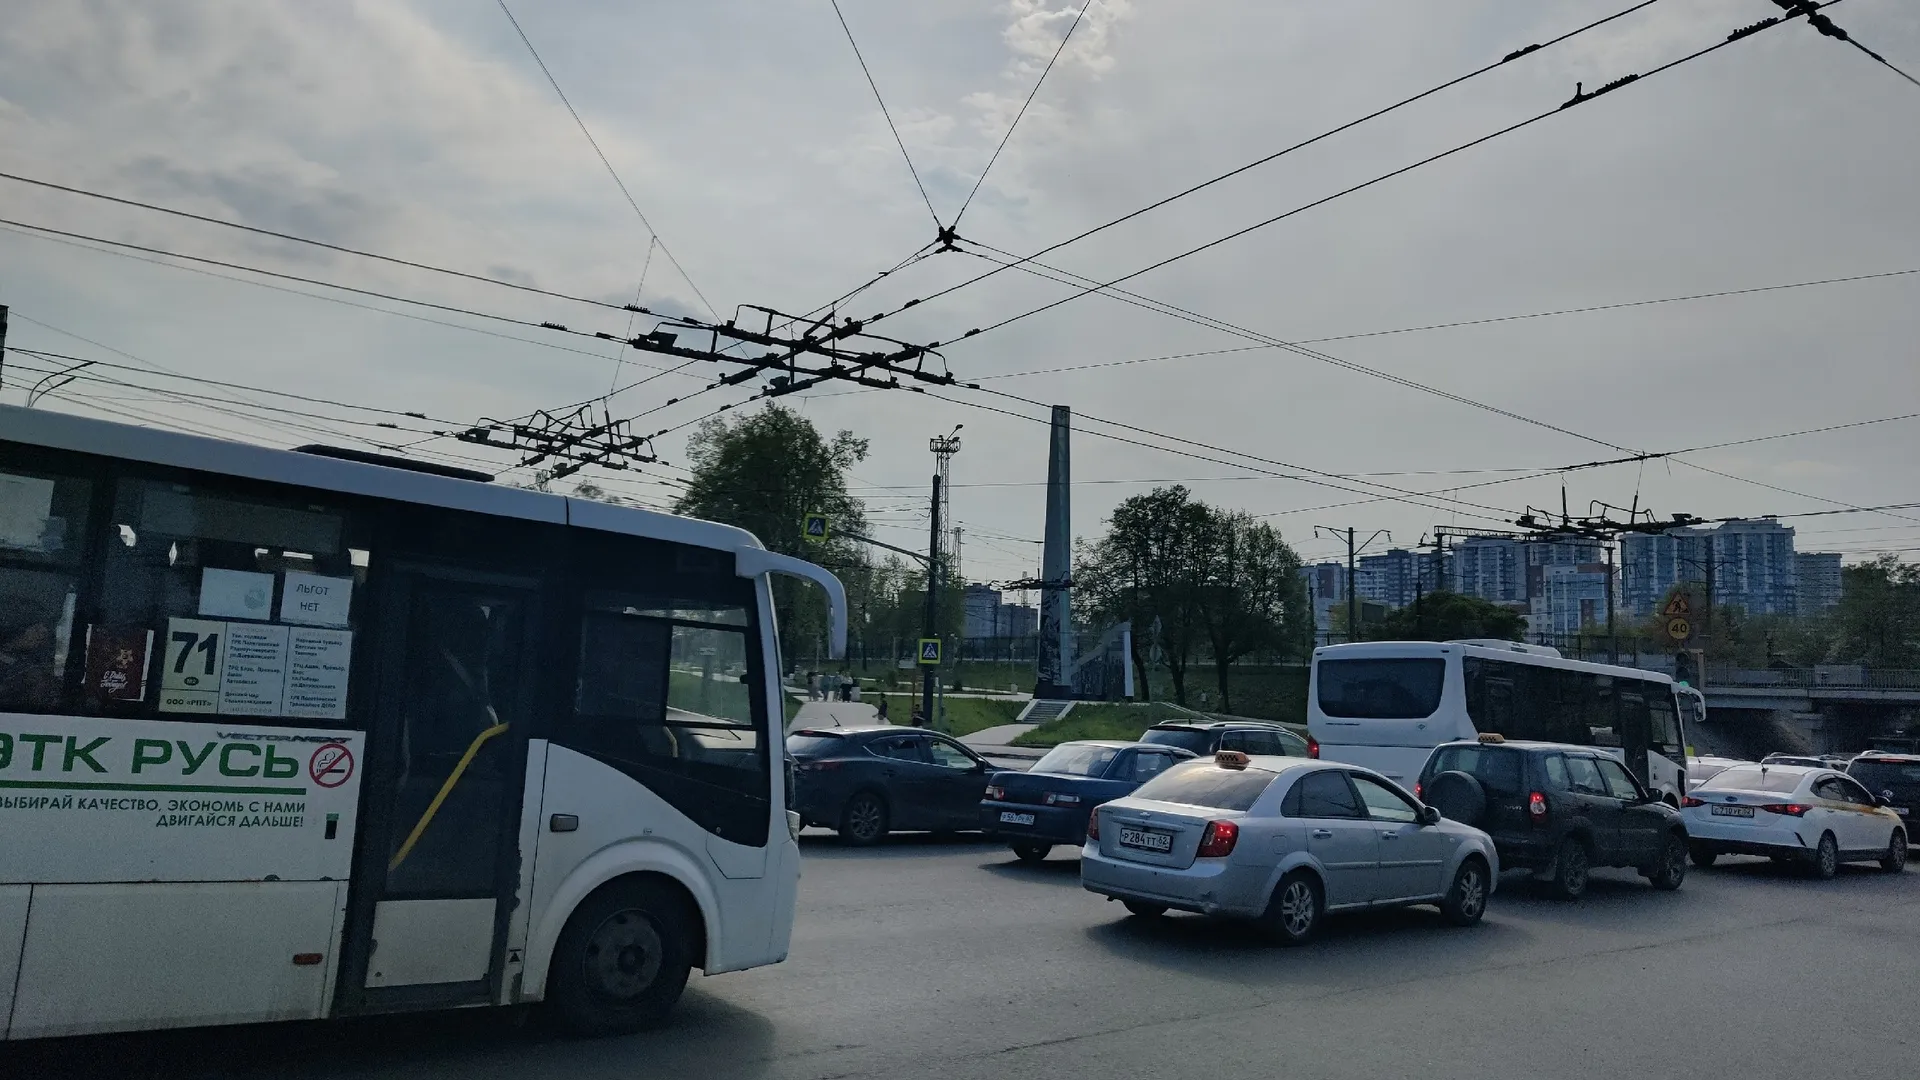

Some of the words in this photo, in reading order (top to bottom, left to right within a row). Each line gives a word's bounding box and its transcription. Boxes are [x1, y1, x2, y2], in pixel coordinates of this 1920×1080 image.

[296, 583, 330, 596] ЛЬГОТ
[300, 602, 321, 612] НЕТ
[1671, 623, 1687, 633] 40
[172, 631, 219, 675] 71
[131, 738, 299, 778] РУСЬ
[77, 797, 162, 812] КАЧЕСТВО,
[167, 799, 244, 812] ЭКОНОМЬ
[249, 801, 260, 812] С
[264, 801, 305, 813] НАМИ
[156, 812, 236, 827] ДВИГАЙСЯ
[239, 815, 304, 828] ДАЛЬШЕ!
